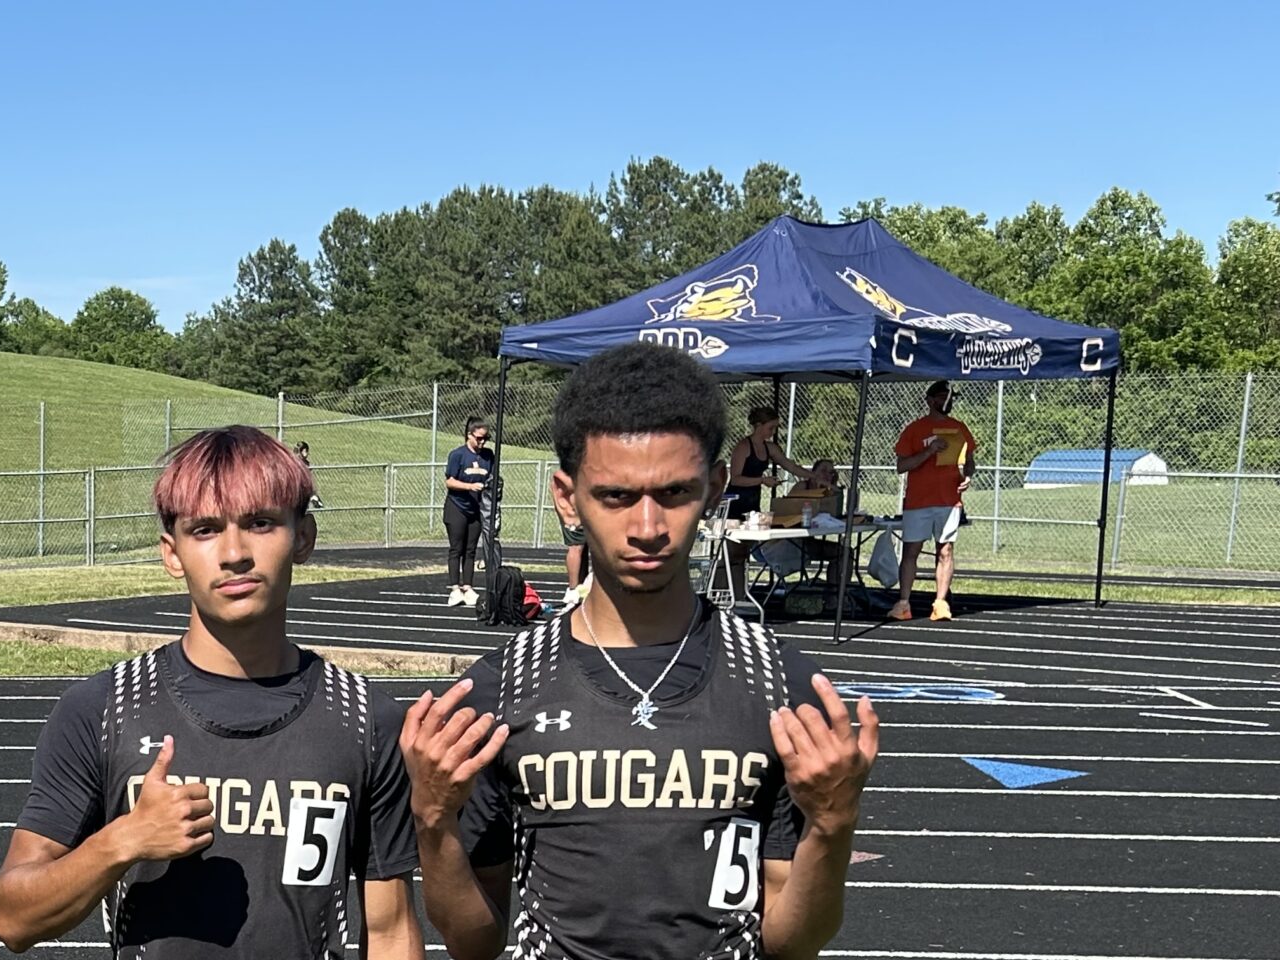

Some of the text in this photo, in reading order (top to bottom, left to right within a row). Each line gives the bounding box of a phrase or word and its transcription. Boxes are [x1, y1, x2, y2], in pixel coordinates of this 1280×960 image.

[517, 748, 769, 811] COUGARS
[297, 806, 336, 882] 5
[723, 824, 754, 907] 5
